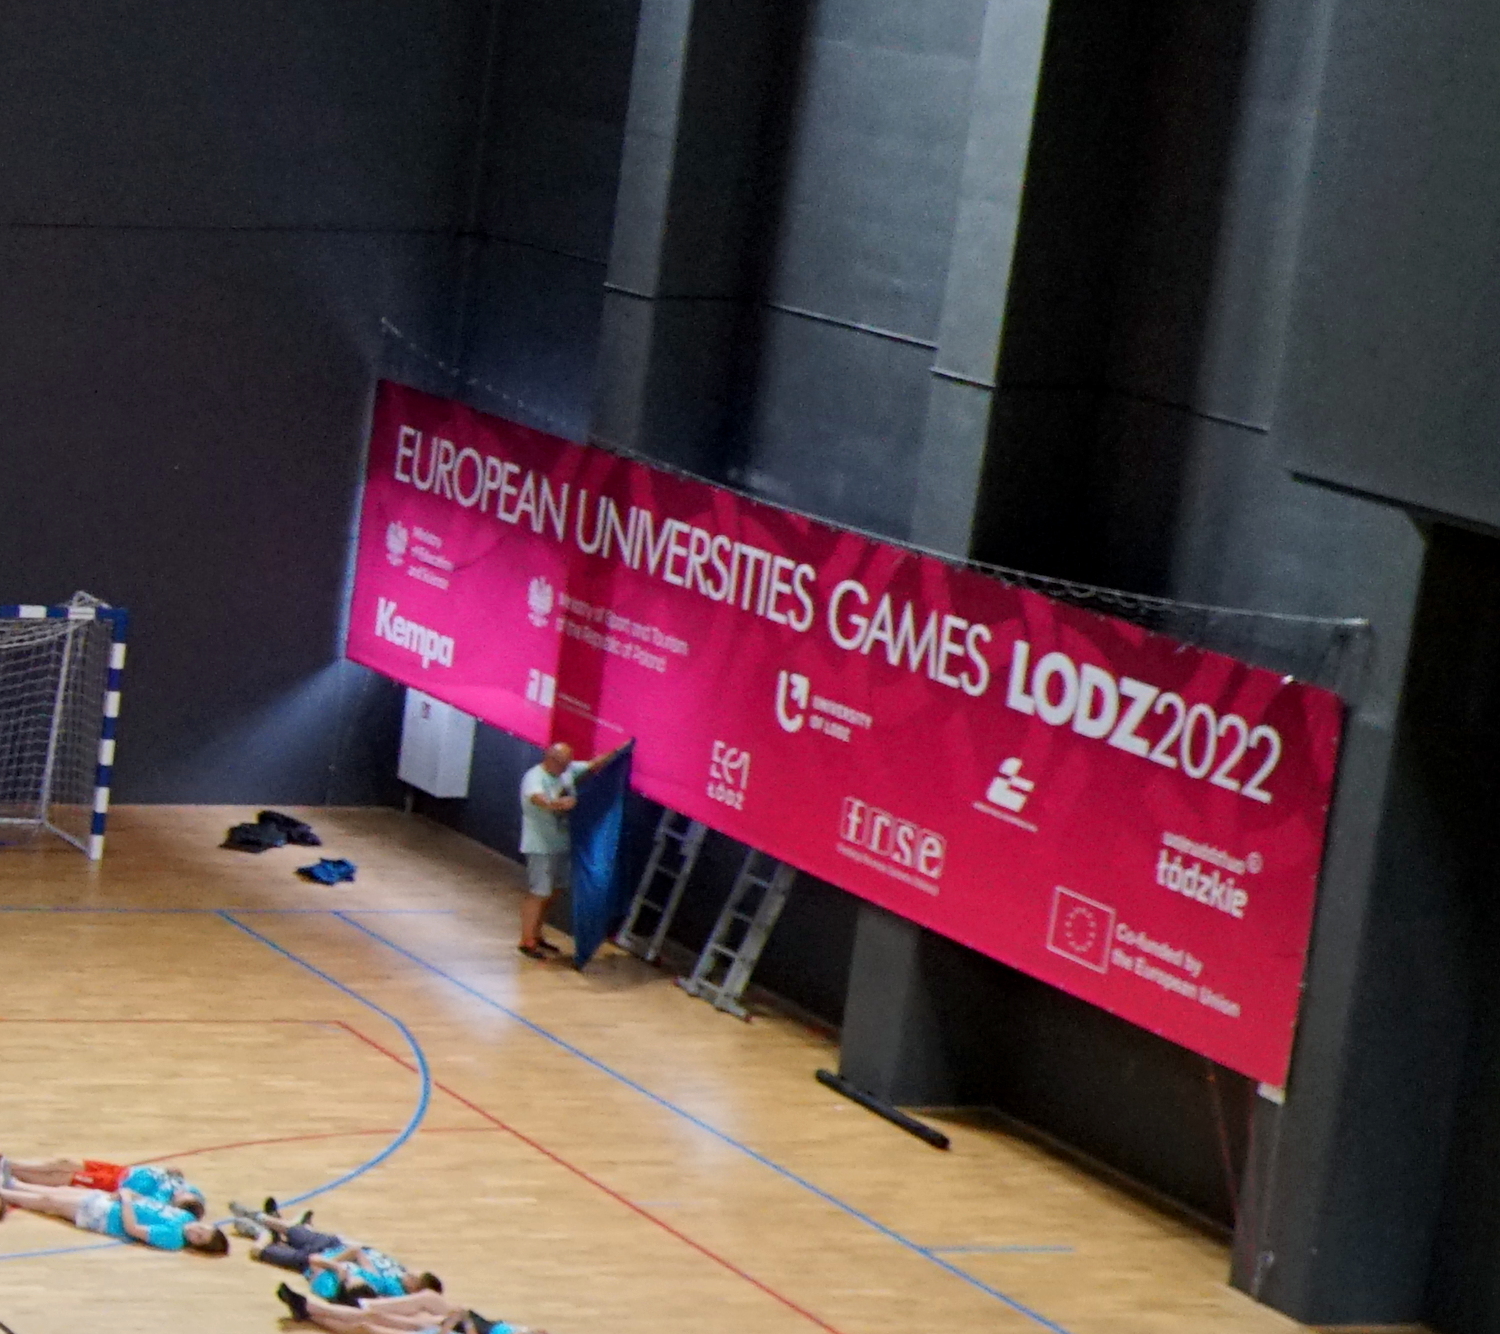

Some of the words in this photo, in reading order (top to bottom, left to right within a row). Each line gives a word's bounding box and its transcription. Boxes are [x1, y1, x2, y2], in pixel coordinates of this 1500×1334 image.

[374, 596, 456, 670] Kempa
[393, 424, 571, 544] EUROPEAN
[575, 488, 816, 632] UNIVERSITIES
[827, 579, 992, 697] GAMES
[1005, 639, 1283, 805] LODZ2022
